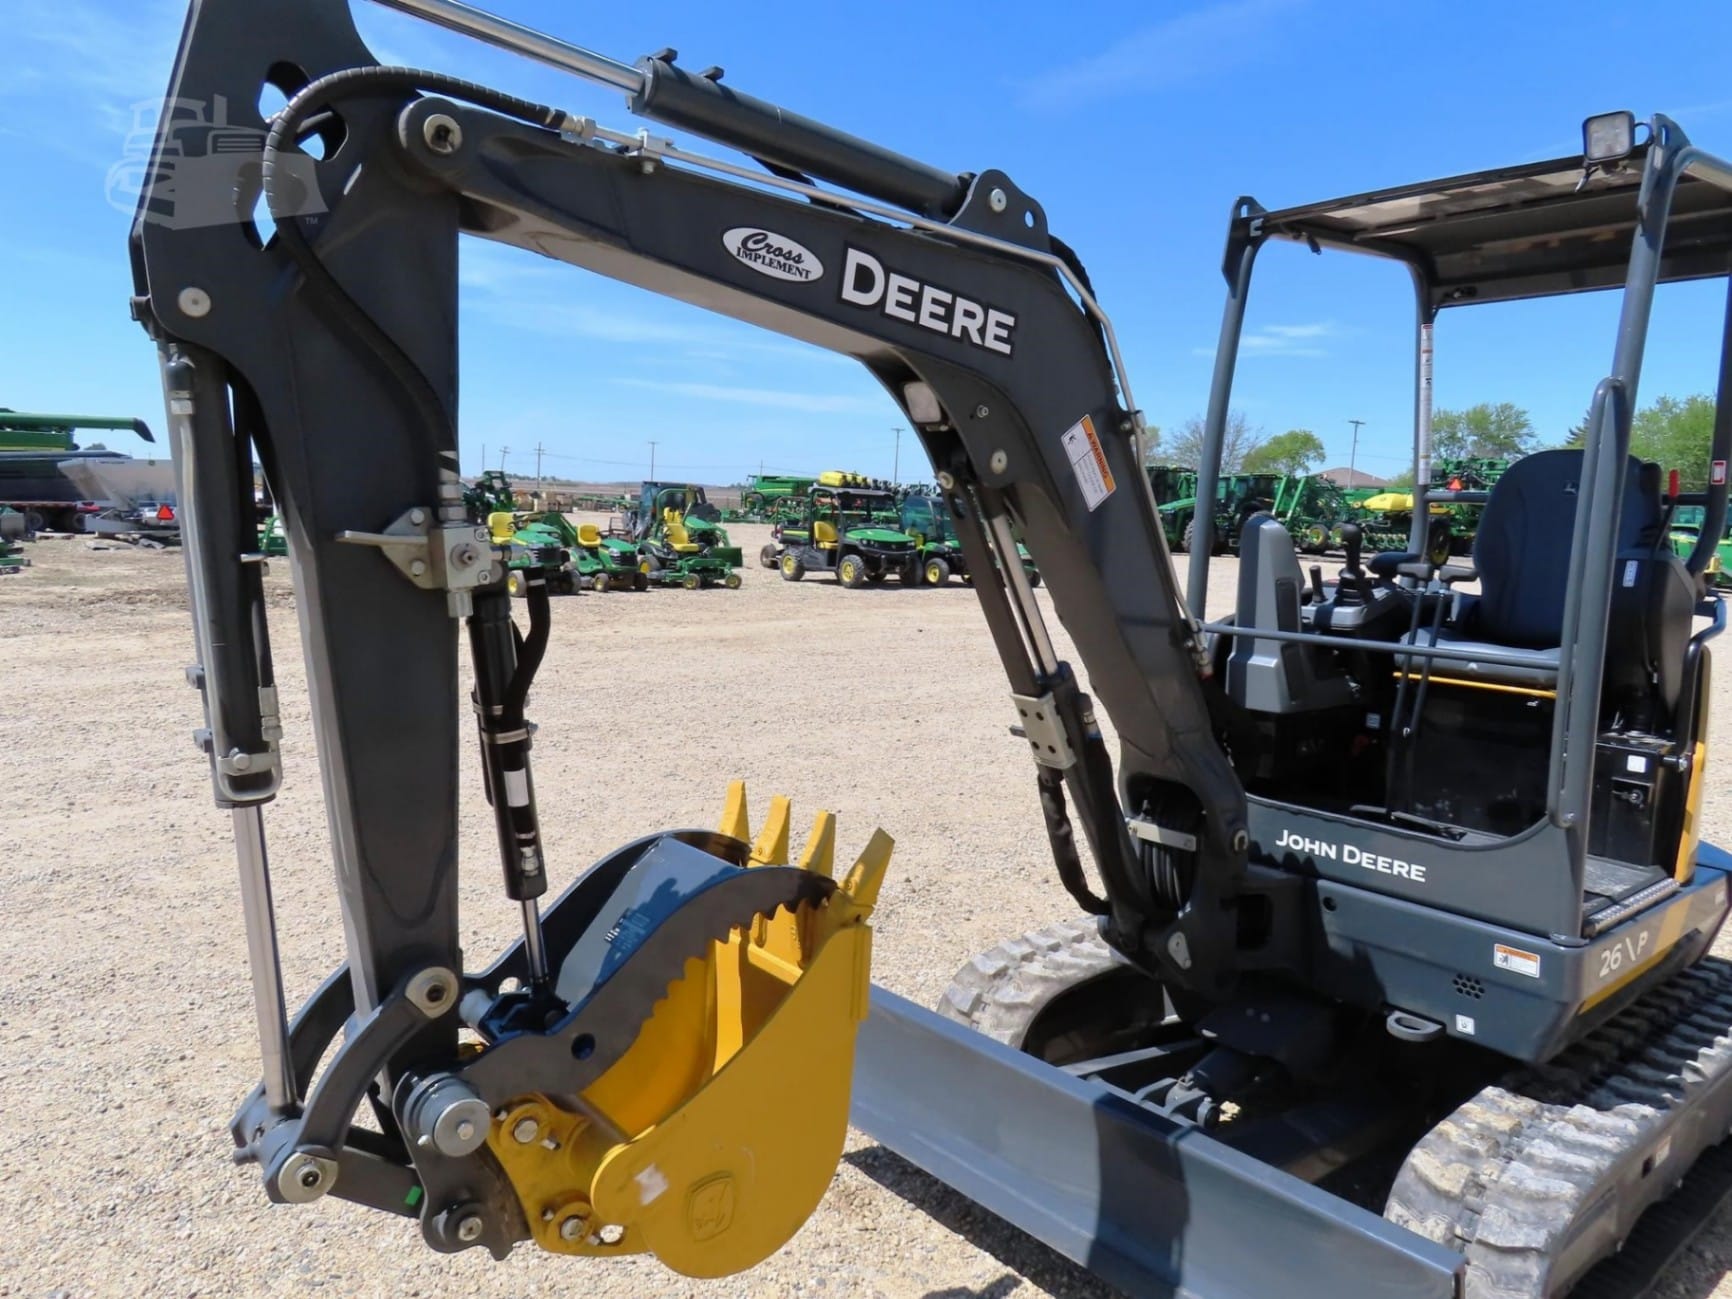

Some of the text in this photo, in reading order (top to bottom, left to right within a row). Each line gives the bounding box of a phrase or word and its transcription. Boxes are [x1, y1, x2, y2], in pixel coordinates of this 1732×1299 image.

[736, 246, 812, 280] IMPLEMENT
[740, 231, 805, 264] Cross
[840, 247, 1016, 355] DEERE
[1275, 829, 1427, 883] JOHN DEERE
